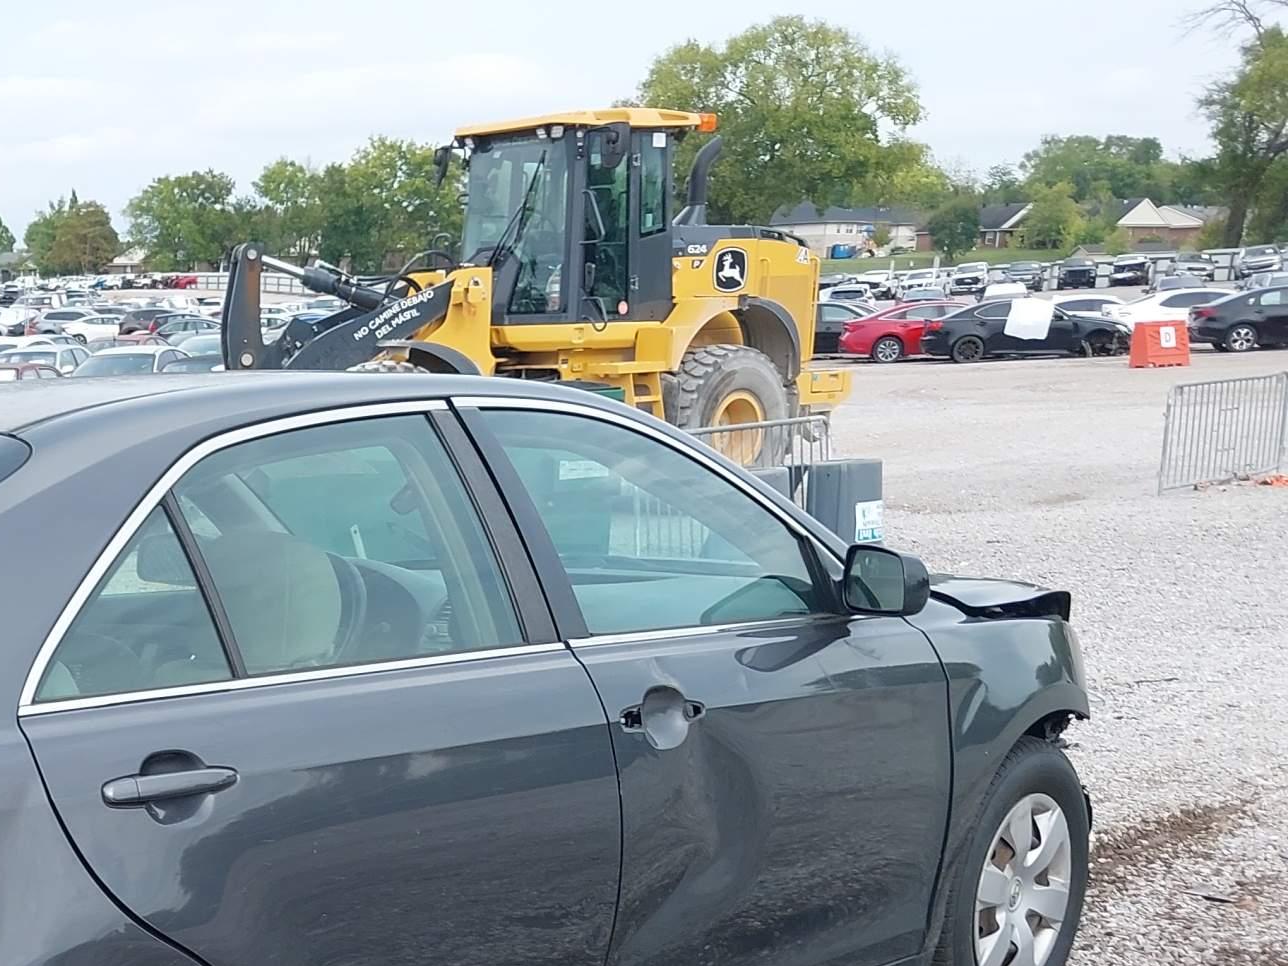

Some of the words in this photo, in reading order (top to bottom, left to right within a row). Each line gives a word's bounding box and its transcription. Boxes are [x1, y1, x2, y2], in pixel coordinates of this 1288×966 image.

[687, 244, 708, 254] 624
[353, 326, 369, 341] NO
[368, 303, 402, 329] CAMINE
[400, 290, 434, 307] DEBAJO
[375, 324, 393, 339] DEL
